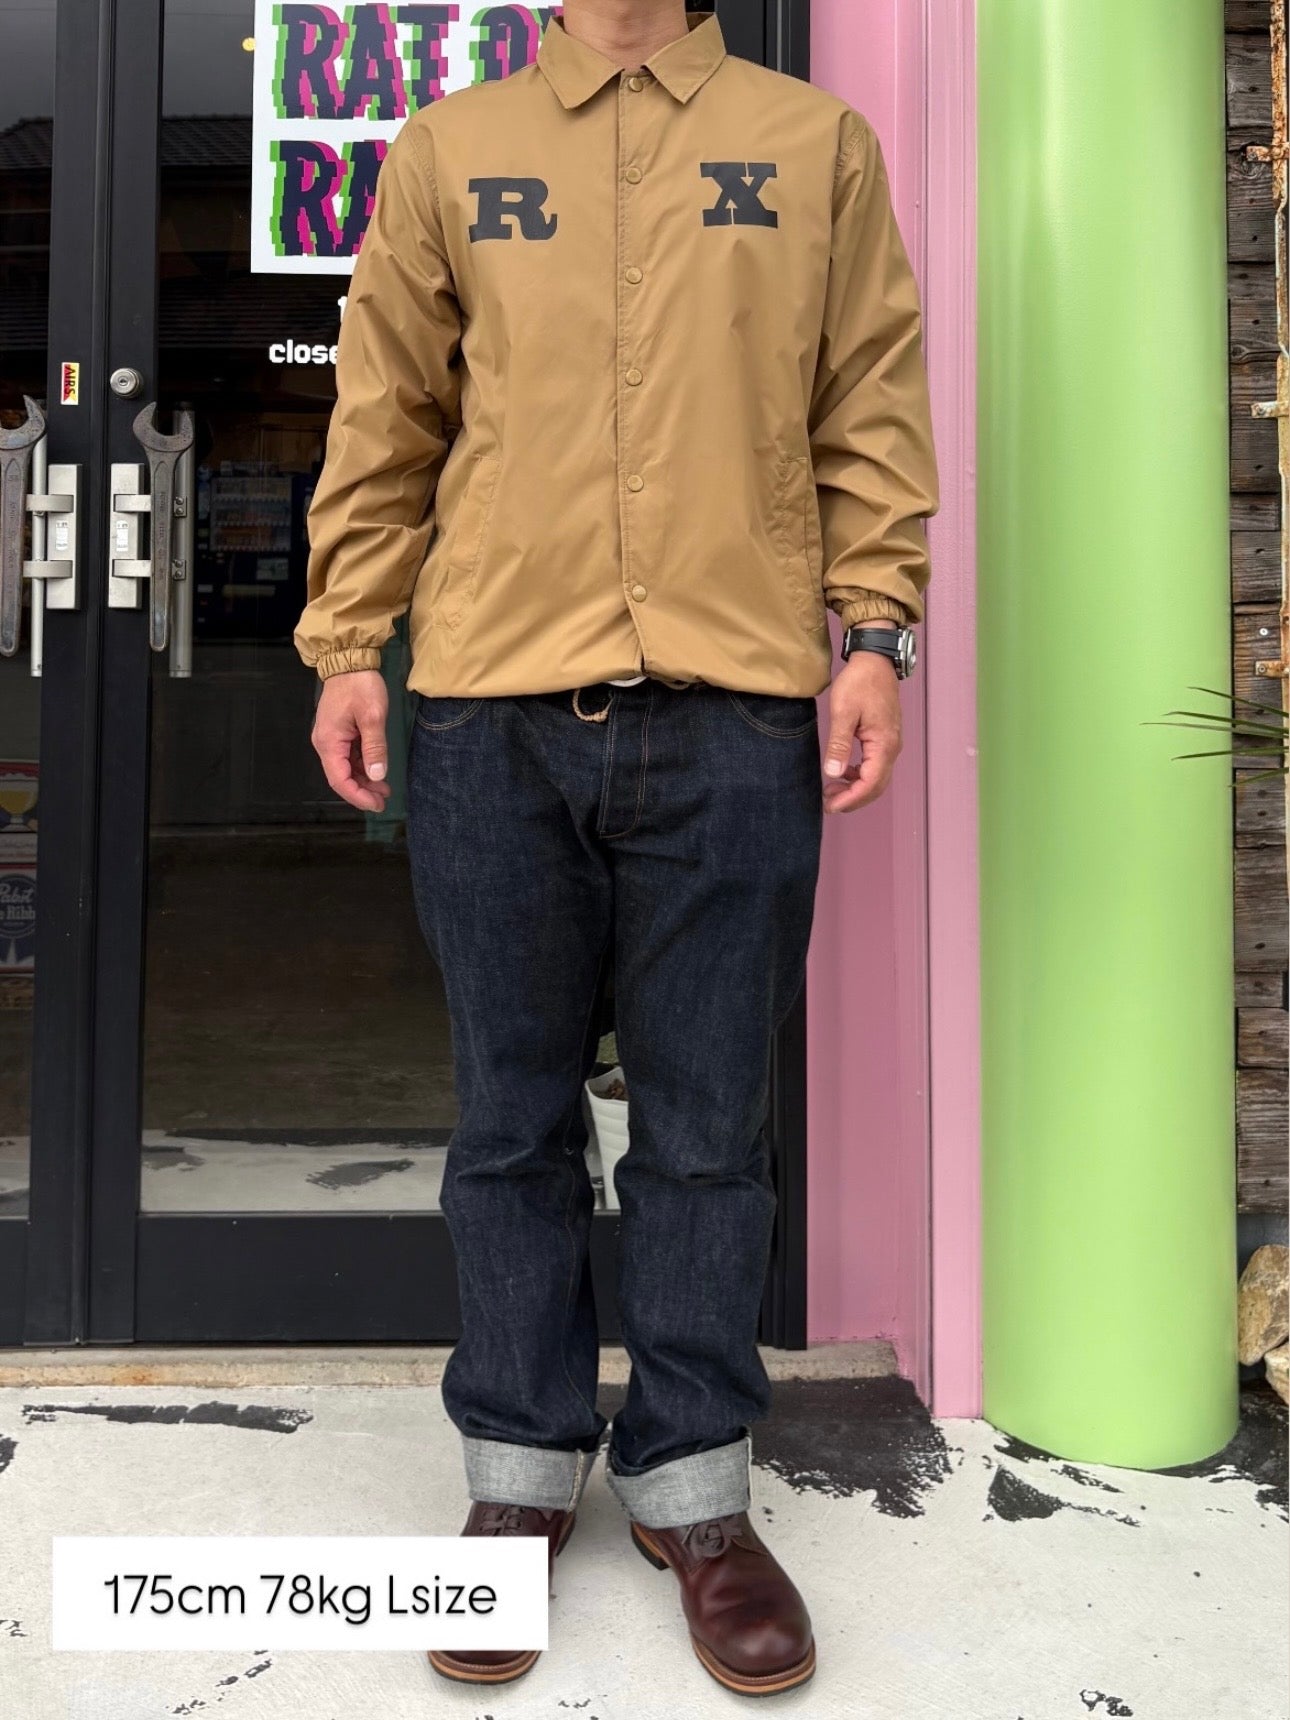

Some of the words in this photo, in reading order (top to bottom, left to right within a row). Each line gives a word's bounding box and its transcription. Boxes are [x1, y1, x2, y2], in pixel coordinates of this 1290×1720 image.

[272, 3, 459, 120] RAT
[469, 3, 565, 86] O
[270, 140, 391, 257] RA
[468, 177, 558, 243] R
[700, 162, 778, 229] X
